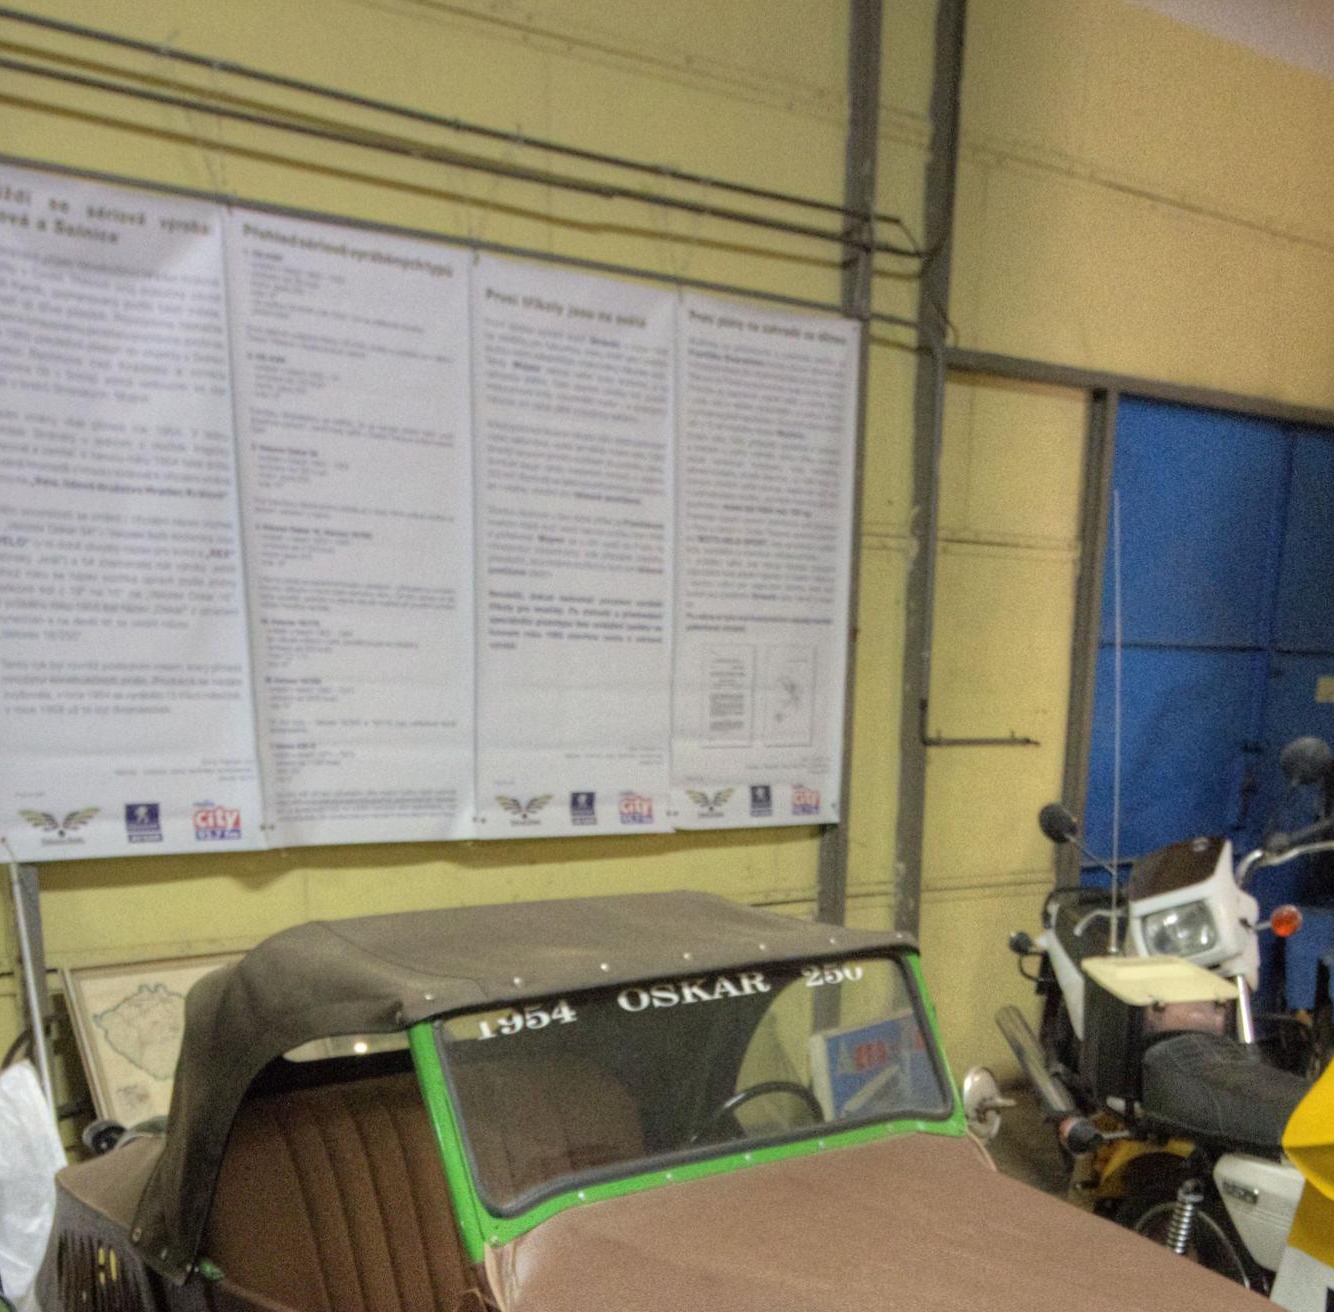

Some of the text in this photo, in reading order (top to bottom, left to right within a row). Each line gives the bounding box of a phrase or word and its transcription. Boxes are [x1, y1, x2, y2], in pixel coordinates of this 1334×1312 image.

[477, 963, 865, 1041] 1954 OSKAR 250
